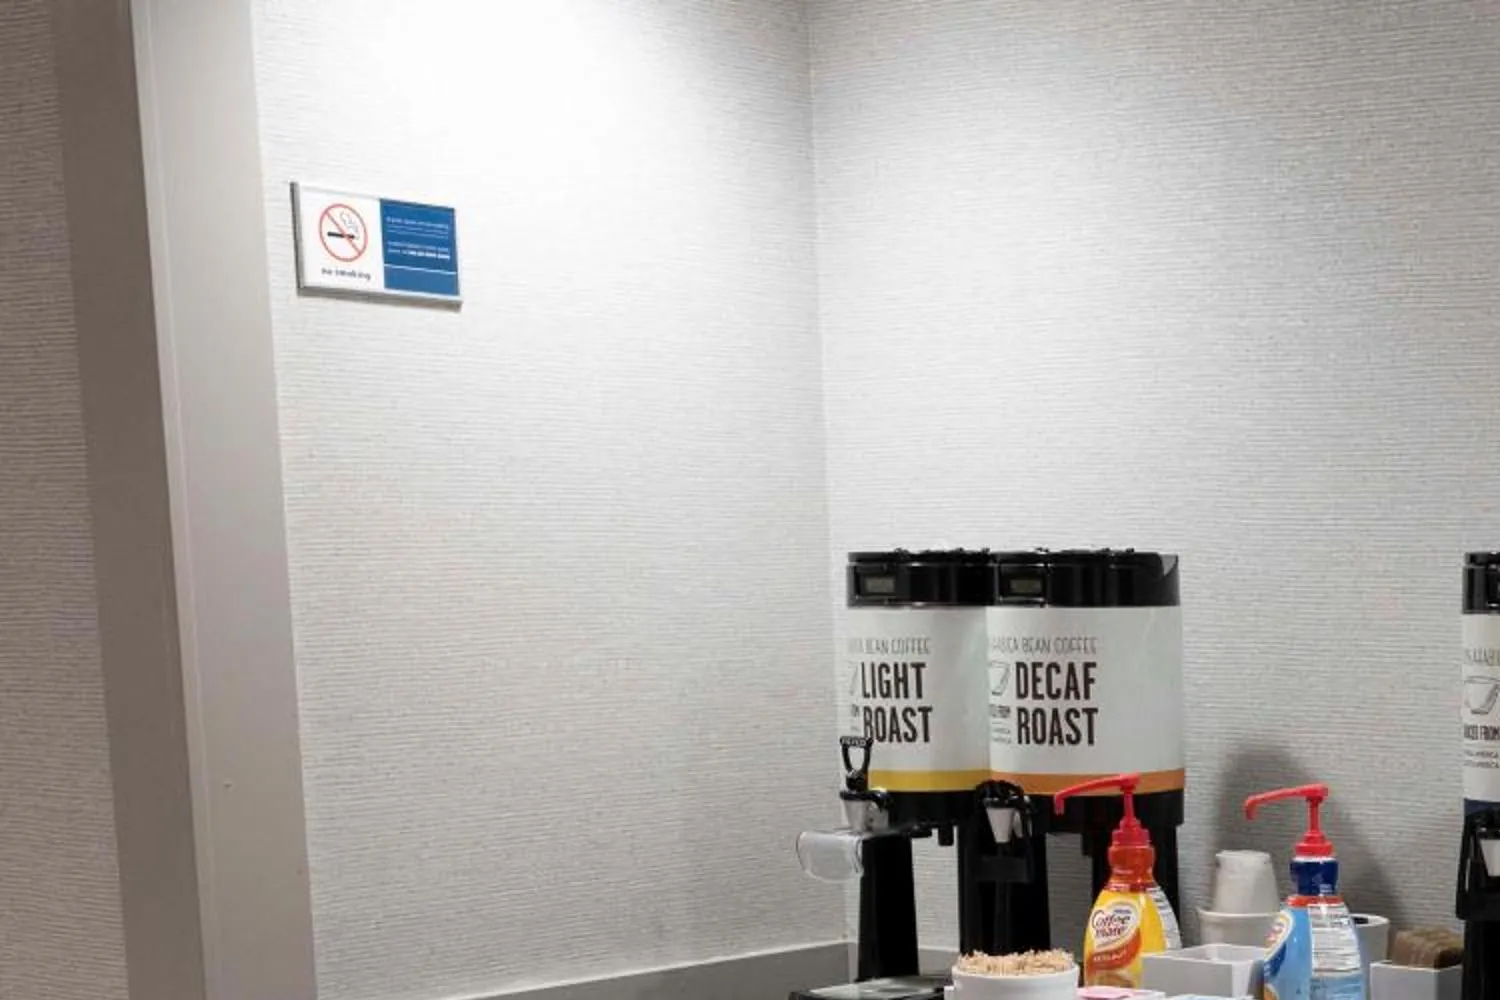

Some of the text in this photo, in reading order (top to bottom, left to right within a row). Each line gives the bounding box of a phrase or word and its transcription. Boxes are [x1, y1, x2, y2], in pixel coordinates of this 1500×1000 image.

[1022, 637, 1051, 653] BEAN
[1055, 637, 1098, 655] COFFEE
[861, 661, 926, 699] LIGHT
[1015, 661, 1097, 700] DECAF
[863, 705, 932, 742] ROAST
[1016, 706, 1098, 745] ROAST
